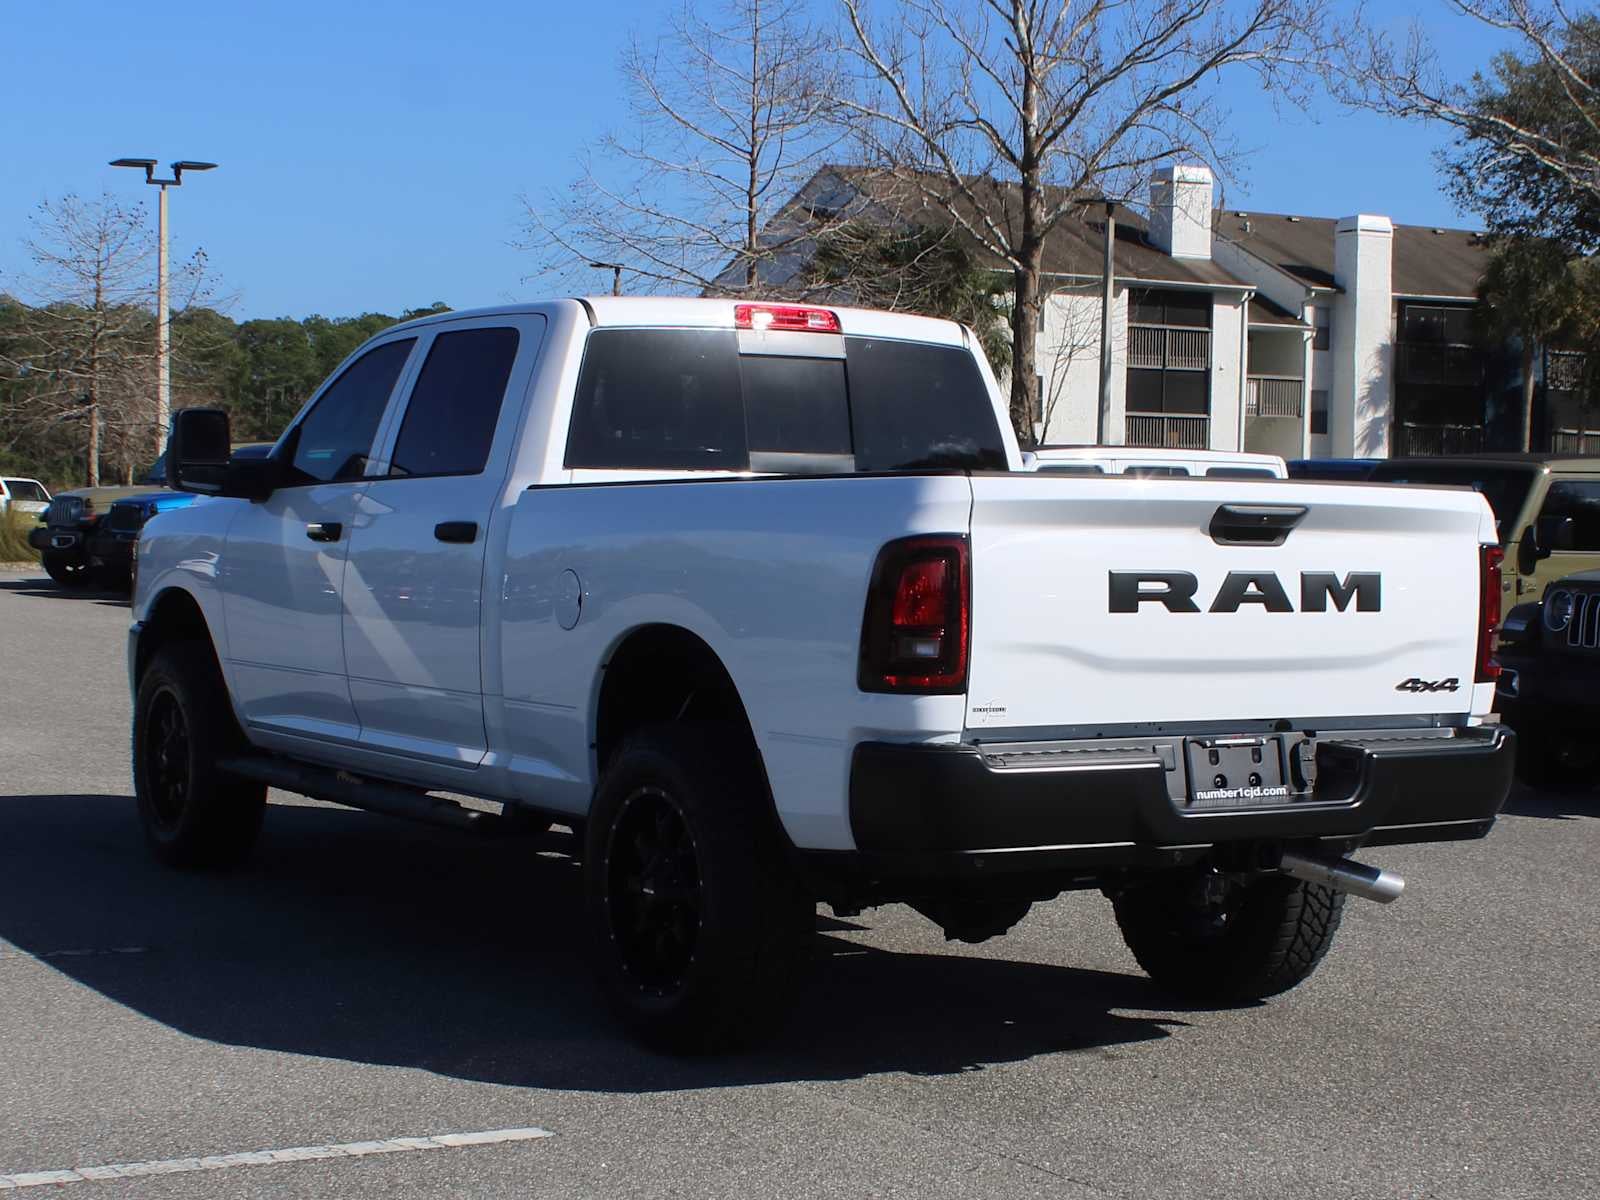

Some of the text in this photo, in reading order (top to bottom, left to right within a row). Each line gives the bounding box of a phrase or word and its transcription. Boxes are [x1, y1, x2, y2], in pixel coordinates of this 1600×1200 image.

[1109, 570, 1382, 613] RAM
[1396, 677, 1460, 693] 4x4
[1196, 786, 1287, 799] number1cjd.com
